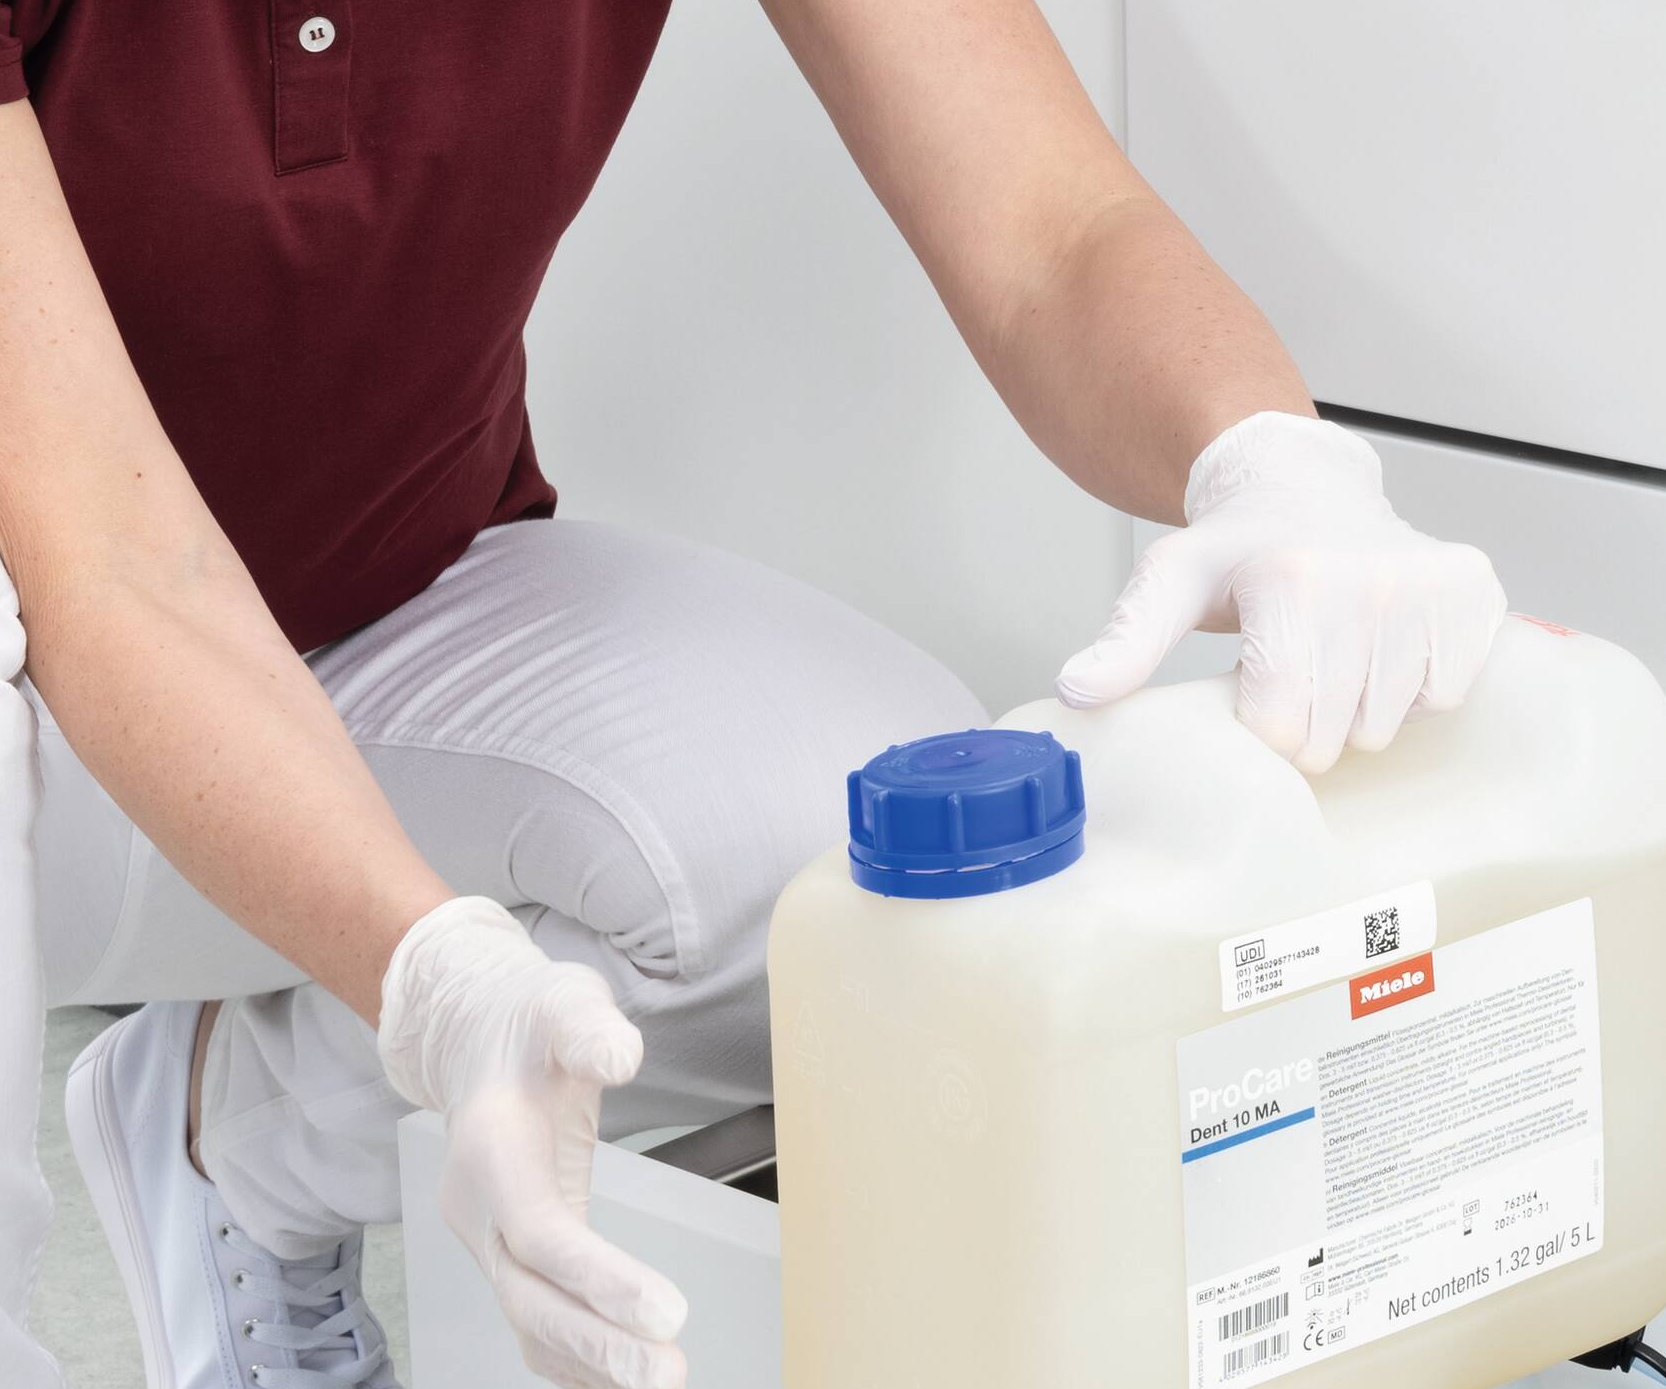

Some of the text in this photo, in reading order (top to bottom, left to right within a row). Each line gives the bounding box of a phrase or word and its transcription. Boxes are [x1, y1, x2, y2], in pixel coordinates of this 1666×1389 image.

[1240, 945, 1262, 963] UDI
[1236, 966, 1251, 981] (01)
[1237, 978, 1252, 992] (17)
[1237, 980, 1283, 1003] (10) 762364
[1359, 970, 1425, 1004] Miele
[1325, 1029, 1391, 1062] Reinigungsmittel
[1189, 1058, 1313, 1122] ProCare
[1328, 1076, 1367, 1100] Detergent
[1190, 1099, 1281, 1144] Dent 10 MA
[1331, 1161, 1398, 1195] Reinigingsmiddel
[1465, 1203, 1478, 1214] LOT
[1504, 1190, 1538, 1212] 762364
[1494, 1201, 1550, 1231] 2026-10-31
[1388, 1292, 1417, 1321] Net
[1422, 1264, 1490, 1308] contents
[1496, 1246, 1530, 1277] 1.32
[1535, 1231, 1566, 1266] gal/
[1571, 1226, 1581, 1248] 5
[1586, 1221, 1596, 1241] L
[1199, 1291, 1213, 1301] REF
[1217, 1282, 1242, 1296] M.-Nr.
[1331, 1330, 1343, 1340] MD
